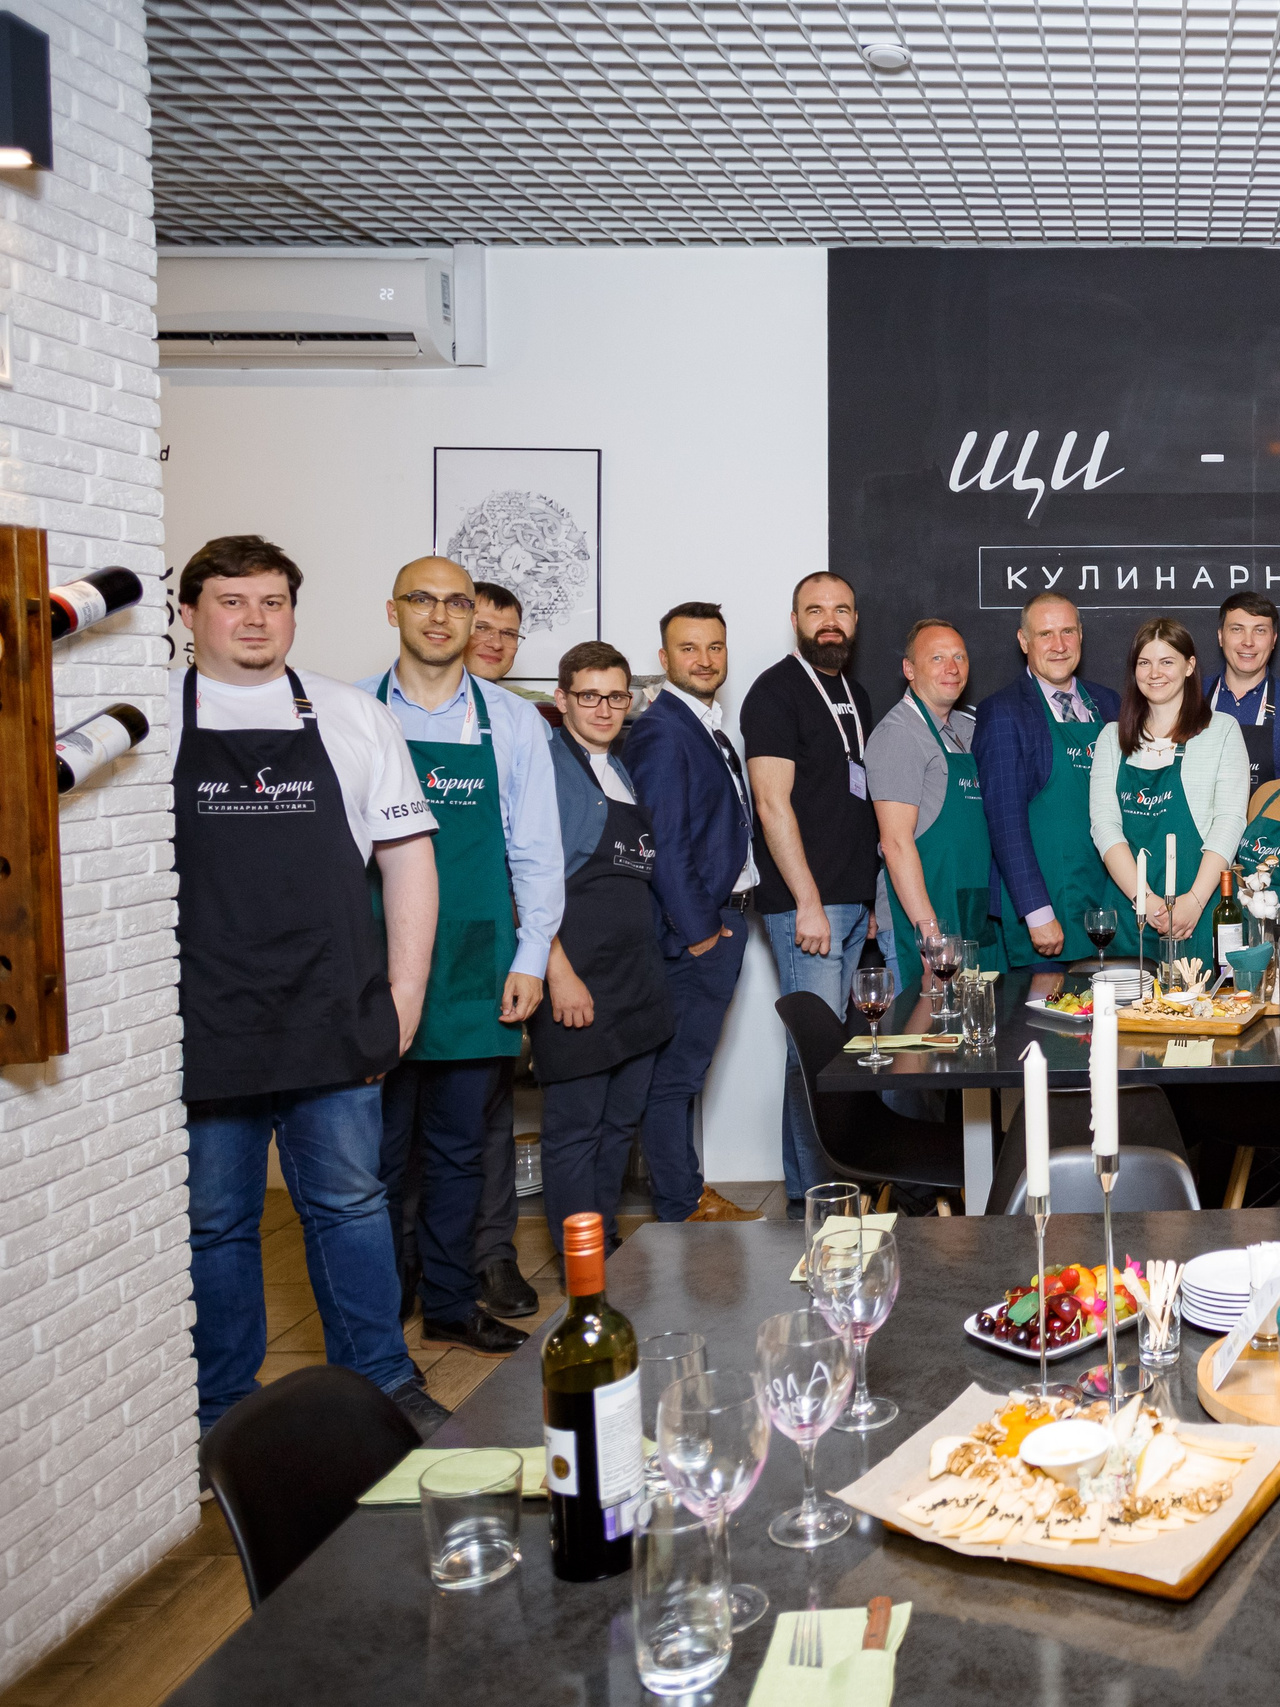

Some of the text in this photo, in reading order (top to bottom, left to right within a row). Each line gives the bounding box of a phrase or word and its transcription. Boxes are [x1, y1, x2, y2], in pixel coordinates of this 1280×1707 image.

[380, 288, 394, 300] 22
[948, 429, 1126, 520] щи
[255, 767, 315, 801] борщи
[426, 766, 485, 798] борщи
[380, 804, 410, 821] YES
